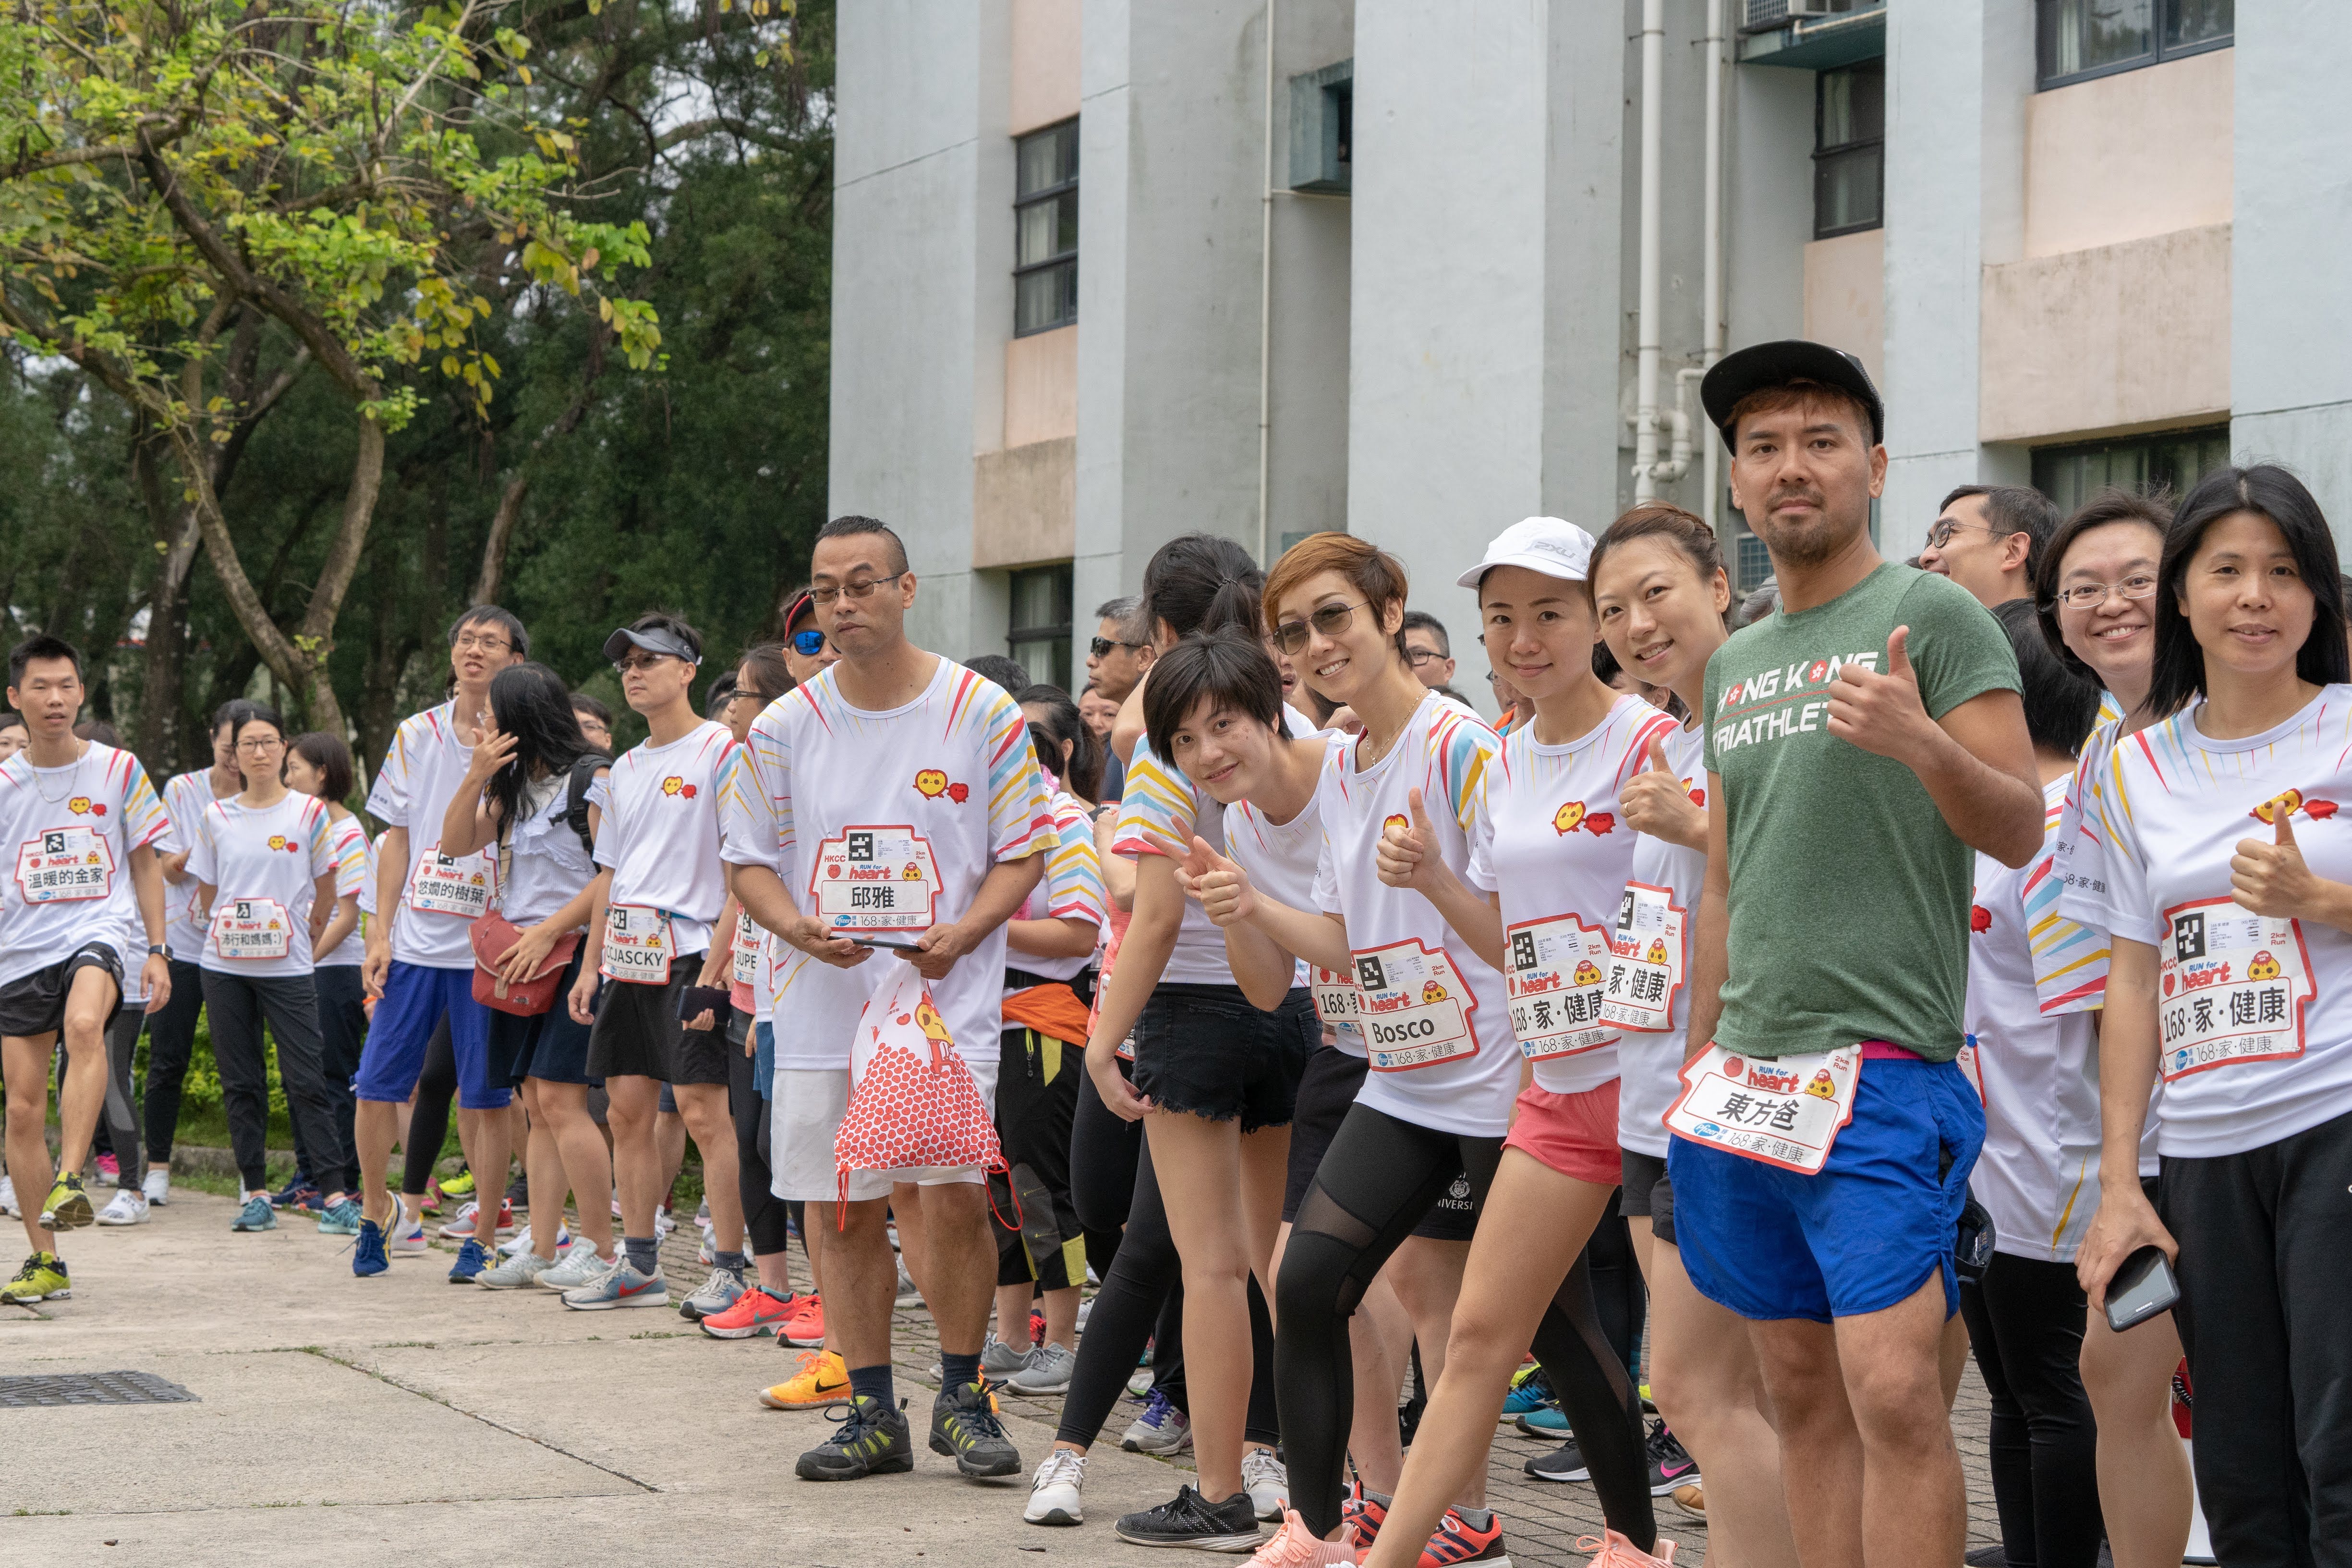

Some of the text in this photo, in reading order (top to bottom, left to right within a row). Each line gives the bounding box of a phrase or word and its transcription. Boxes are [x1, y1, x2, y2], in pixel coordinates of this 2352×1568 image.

[1535, 542, 1576, 559] 2XU
[48, 855, 79, 866] heart
[436, 867, 464, 881] heart
[849, 864, 892, 880] heart
[851, 886, 895, 909] 邱雅
[835, 916, 851, 926] Pfizer
[614, 931, 638, 945] heart
[2189, 962, 2204, 972] RUN
[1519, 971, 1561, 995] heart
[2182, 961, 2231, 992] heart
[1368, 992, 1412, 1012] heart
[1833, 1062, 1848, 1072] Run
[1834, 1056, 1850, 1065] 2km
[1747, 1063, 1800, 1093] heart
[1759, 1066, 1788, 1076] RUN for
[1717, 1092, 1800, 1131] 東方爸
[1695, 1124, 1719, 1135] Pfizer
